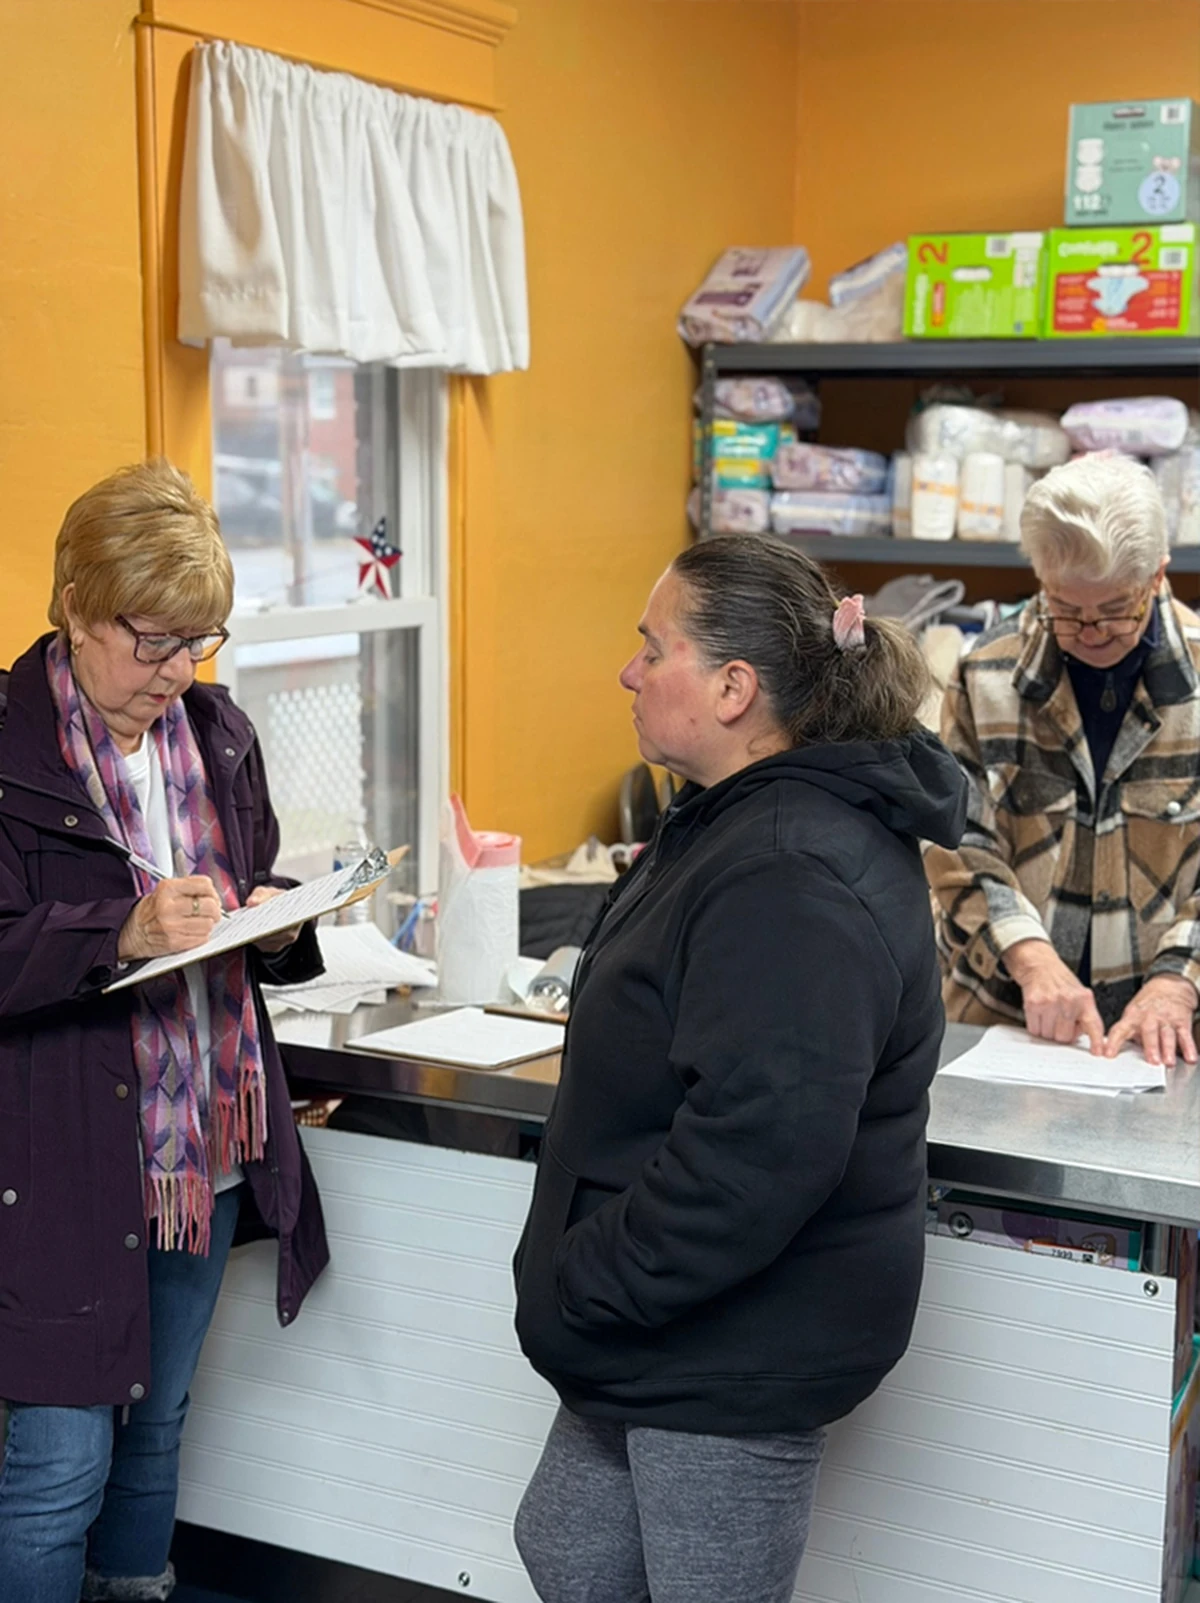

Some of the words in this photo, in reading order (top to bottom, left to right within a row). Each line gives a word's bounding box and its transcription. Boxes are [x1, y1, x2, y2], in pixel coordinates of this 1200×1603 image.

[1153, 175, 1166, 195] 2
[918, 241, 948, 265] 2
[1131, 231, 1152, 265] 2
